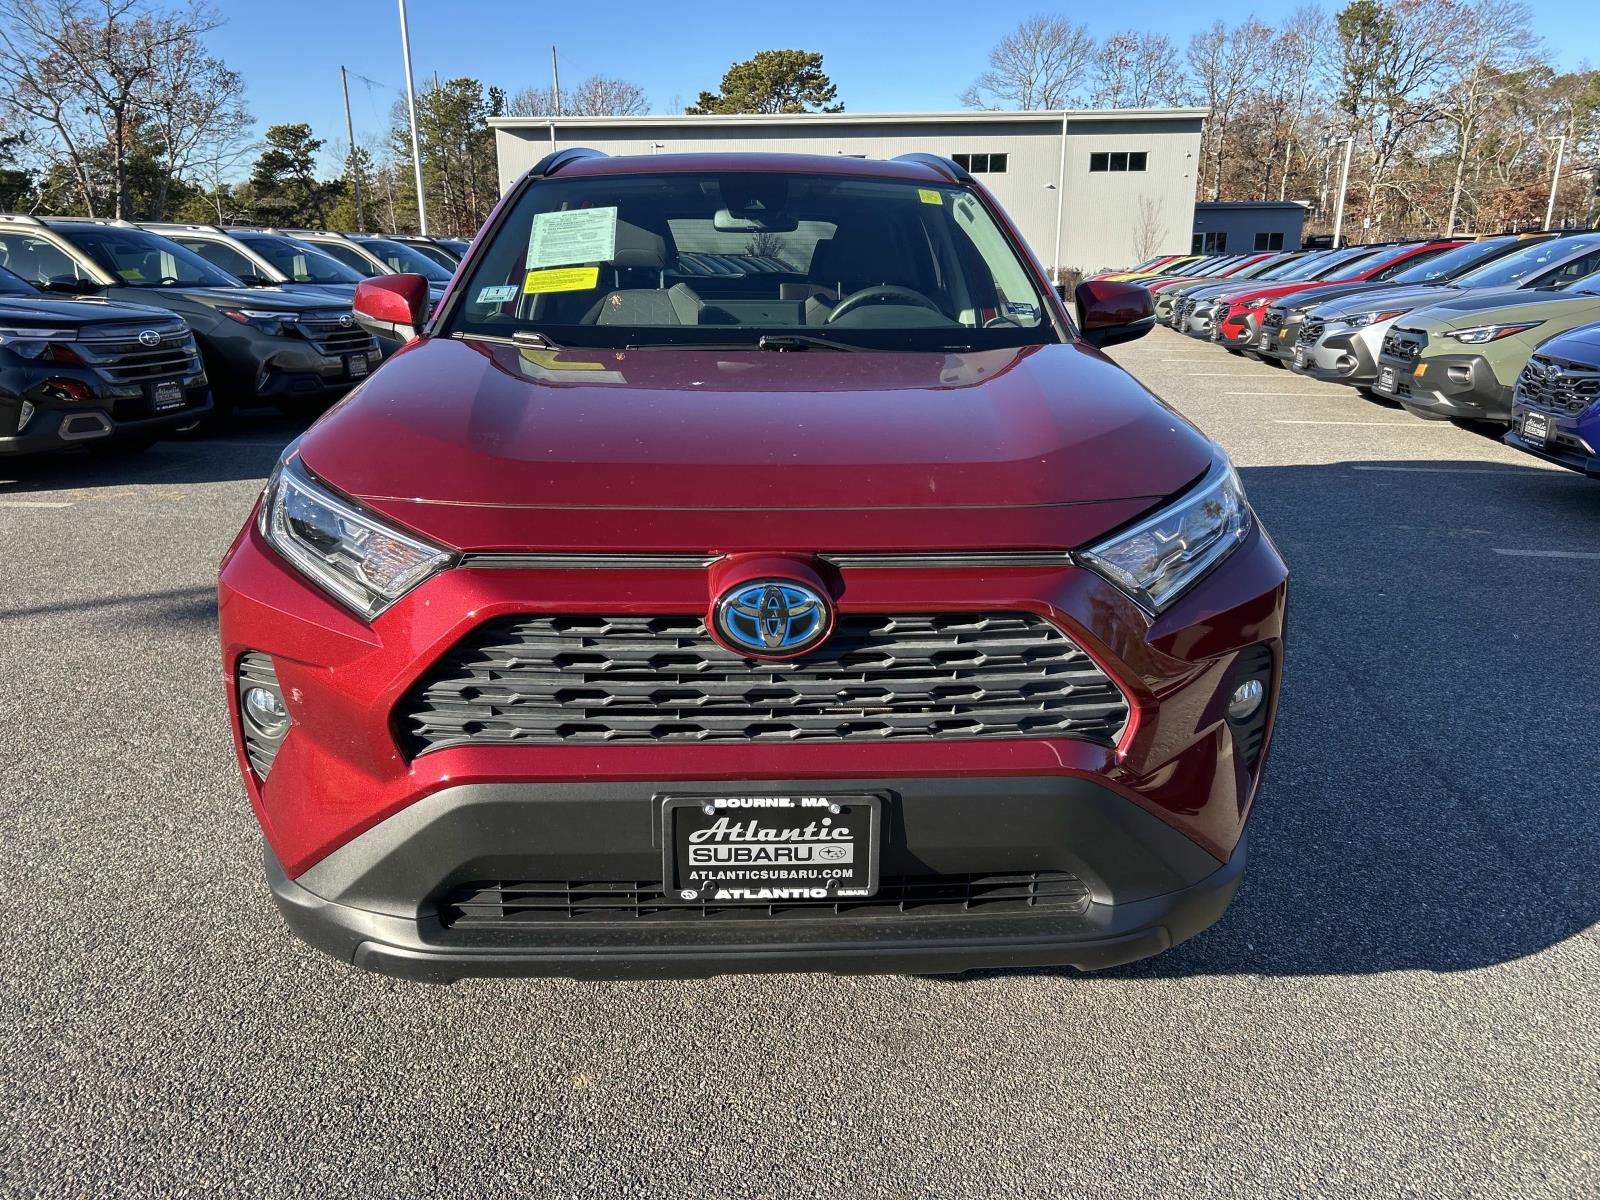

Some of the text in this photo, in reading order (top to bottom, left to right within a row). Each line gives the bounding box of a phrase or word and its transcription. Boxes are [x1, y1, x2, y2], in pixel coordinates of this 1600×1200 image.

[714, 798, 830, 808] BOURNE, MA
[688, 817, 854, 843] Atlantic
[692, 847, 813, 863] SUBARU
[689, 868, 854, 880] ATLANTICSUBARU.COM
[714, 888, 828, 899] ATLANTIC
